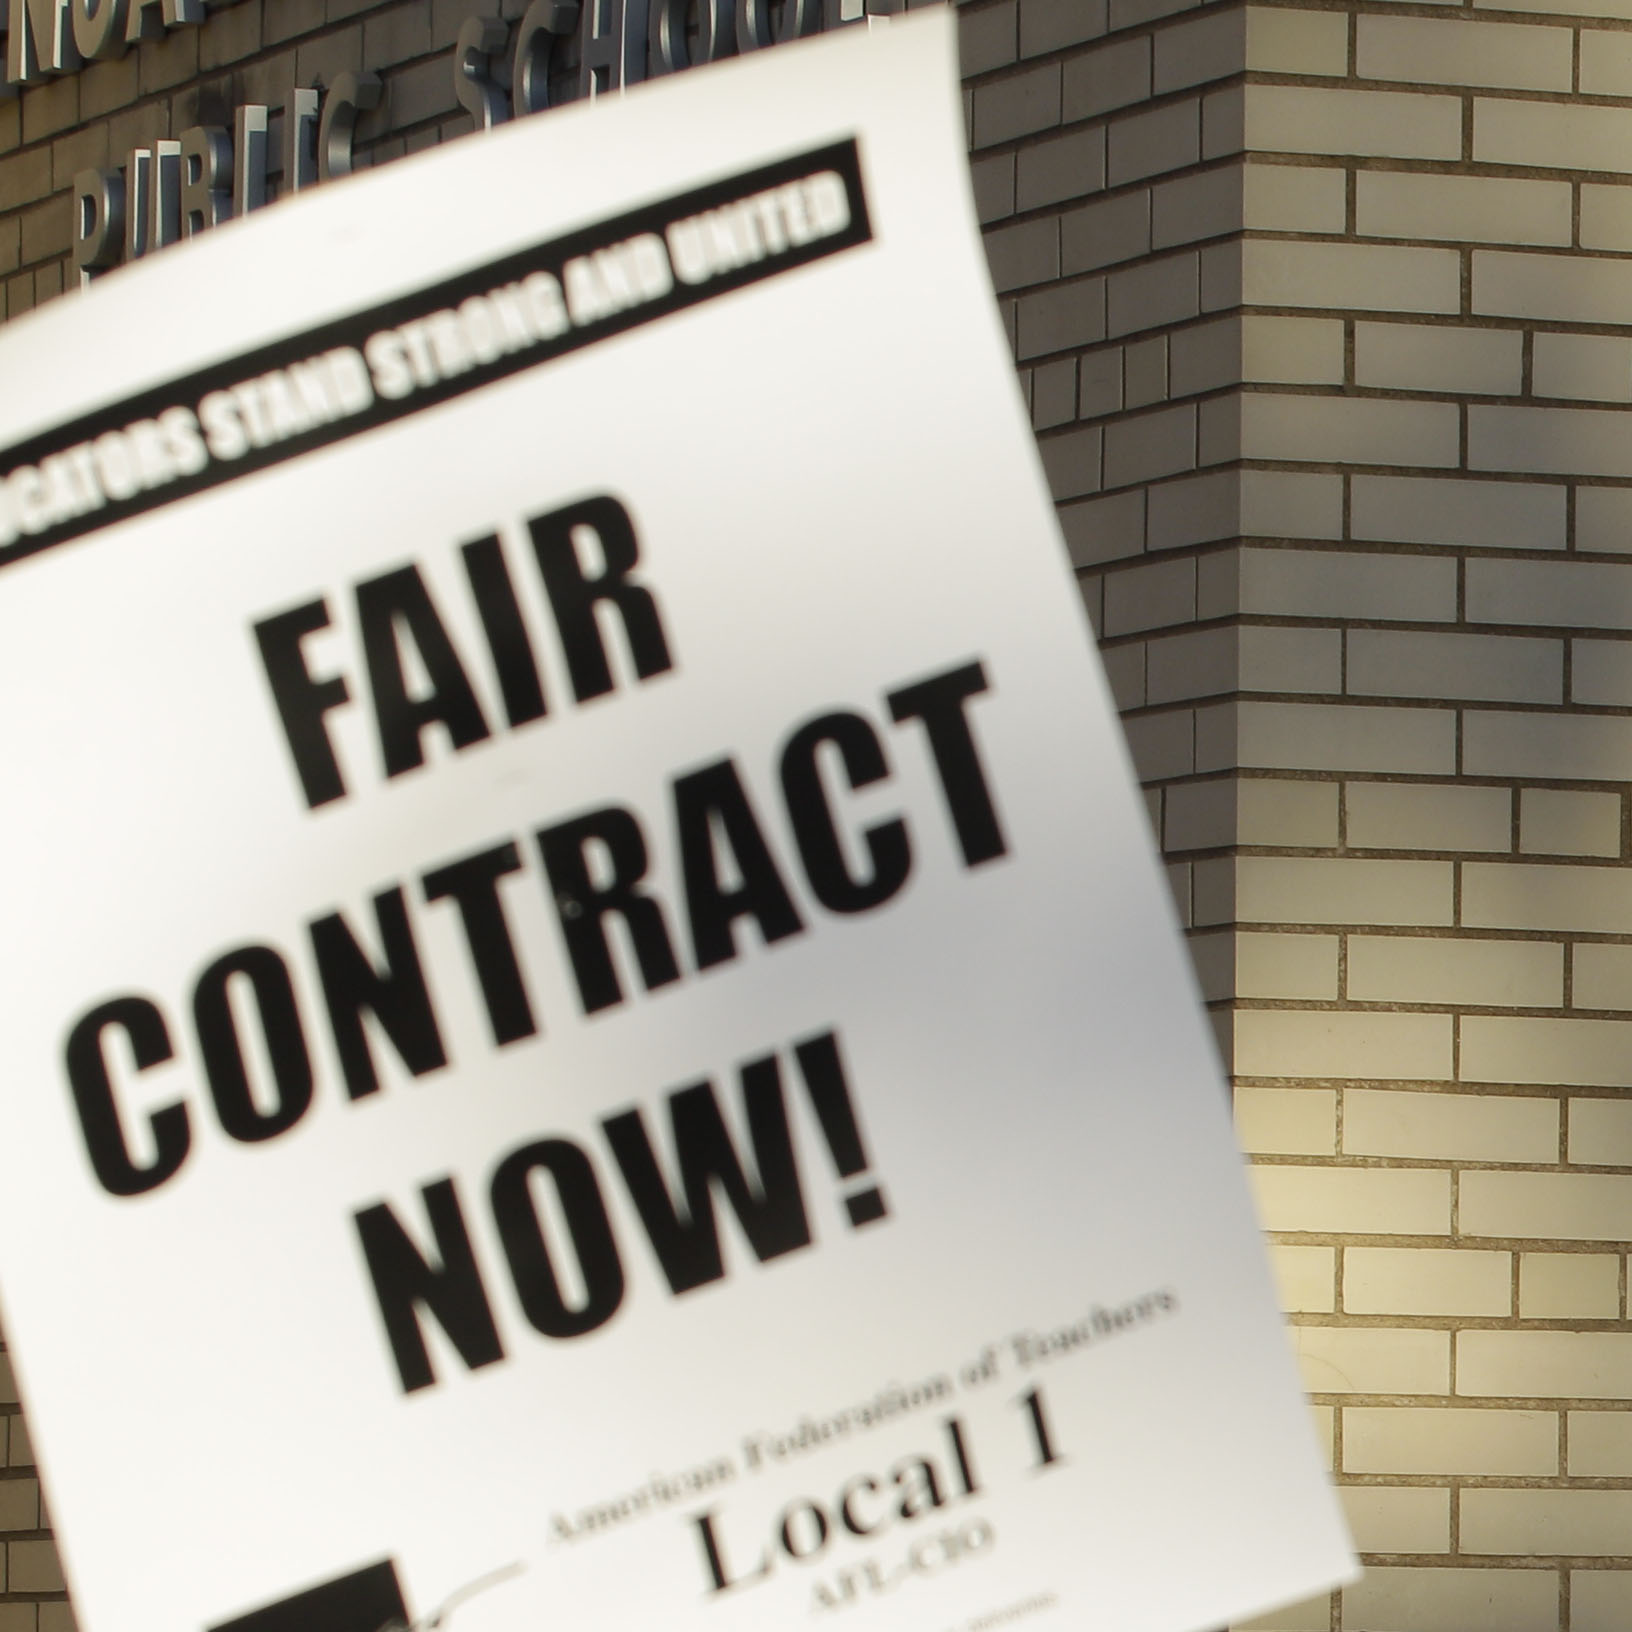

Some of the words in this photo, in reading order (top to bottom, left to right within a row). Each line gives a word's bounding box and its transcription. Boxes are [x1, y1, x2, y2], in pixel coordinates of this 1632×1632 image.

[0, 404, 208, 548] CATORS
[198, 346, 374, 460] STAND
[364, 271, 570, 401] STRONG
[563, 232, 673, 327] AND
[666, 169, 851, 285] UNITED
[247, 488, 679, 812] FAIR
[60, 656, 1013, 1202] CONTRACT
[352, 1026, 892, 1398] NOW!
[690, 1413, 987, 1598] Local
[1018, 1380, 1069, 1475] 1
[807, 1515, 999, 1616] AFL-CIO
